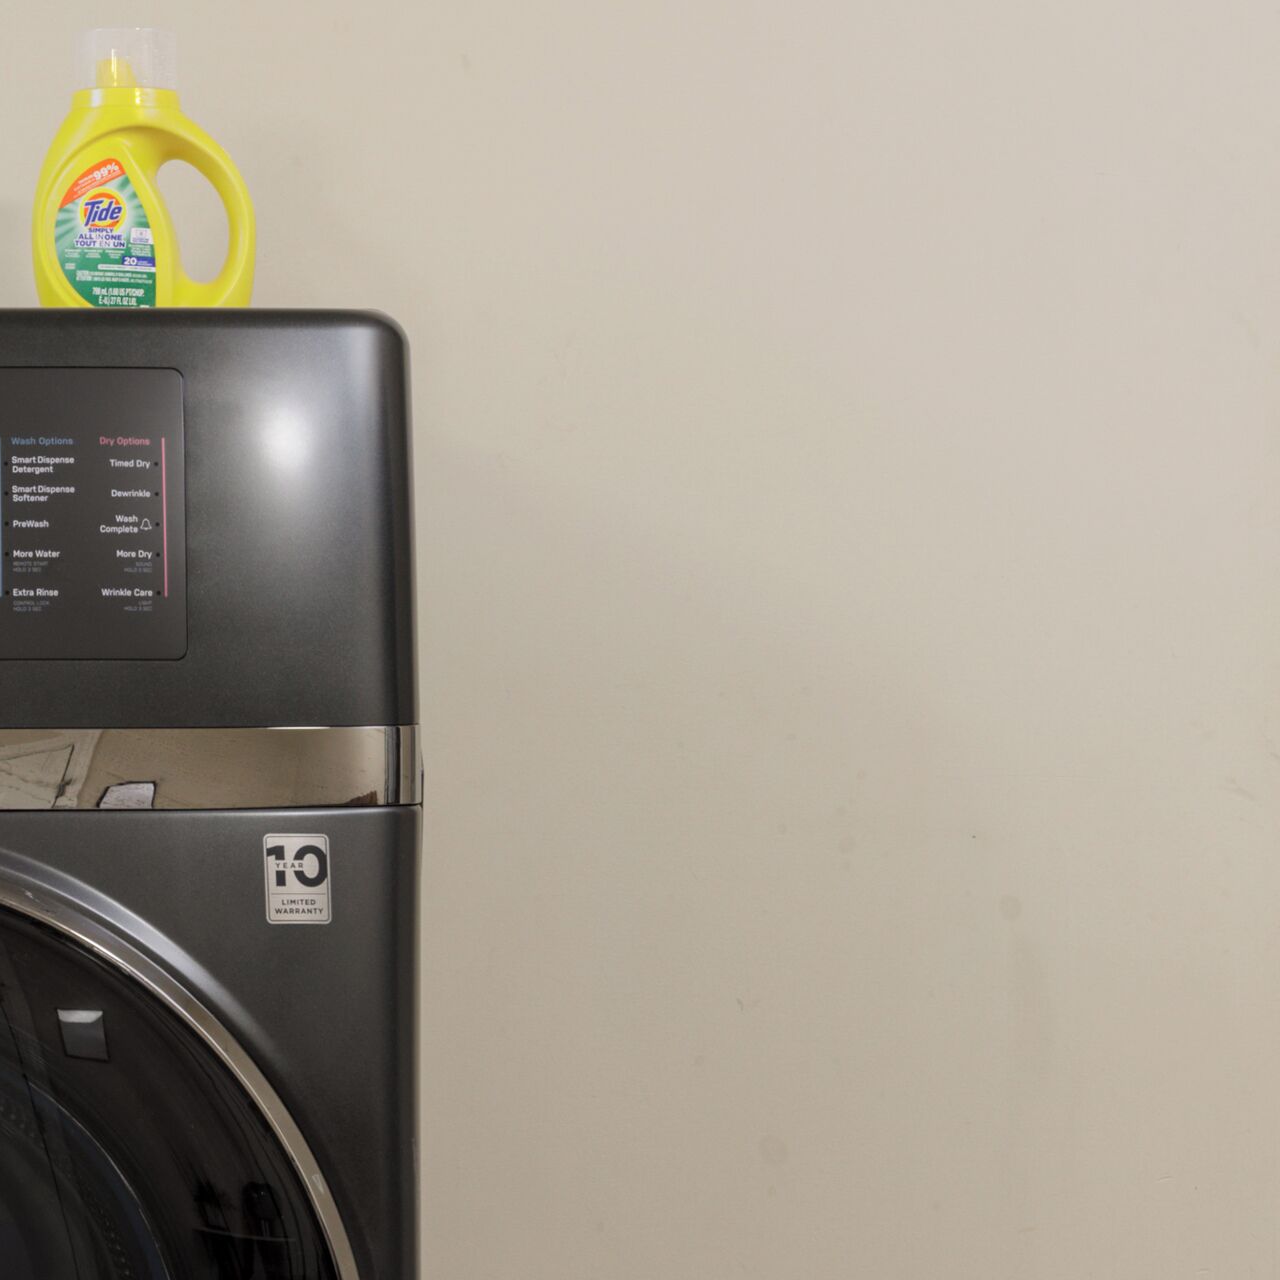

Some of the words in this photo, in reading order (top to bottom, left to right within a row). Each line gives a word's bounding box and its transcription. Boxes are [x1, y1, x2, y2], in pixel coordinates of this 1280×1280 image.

[93, 162, 119, 178] 99%
[84, 200, 122, 227] Tide
[124, 257, 137, 265] 20
[11, 437, 36, 445] Wash
[39, 437, 73, 446] Options
[99, 437, 115, 446] Dry
[117, 437, 150, 446] Options
[136, 460, 150, 469] Dry
[12, 466, 53, 474] Detergent
[13, 494, 48, 502] Softener
[115, 515, 138, 523] Wash
[13, 520, 49, 528] PreWash
[100, 525, 139, 533] Complete
[13, 550, 33, 558] More
[35, 550, 60, 558] Water
[117, 550, 136, 558] More
[138, 550, 152, 559] Dry
[36, 589, 58, 597] Rinse
[134, 589, 153, 597] Care
[266, 845, 327, 887] 10
